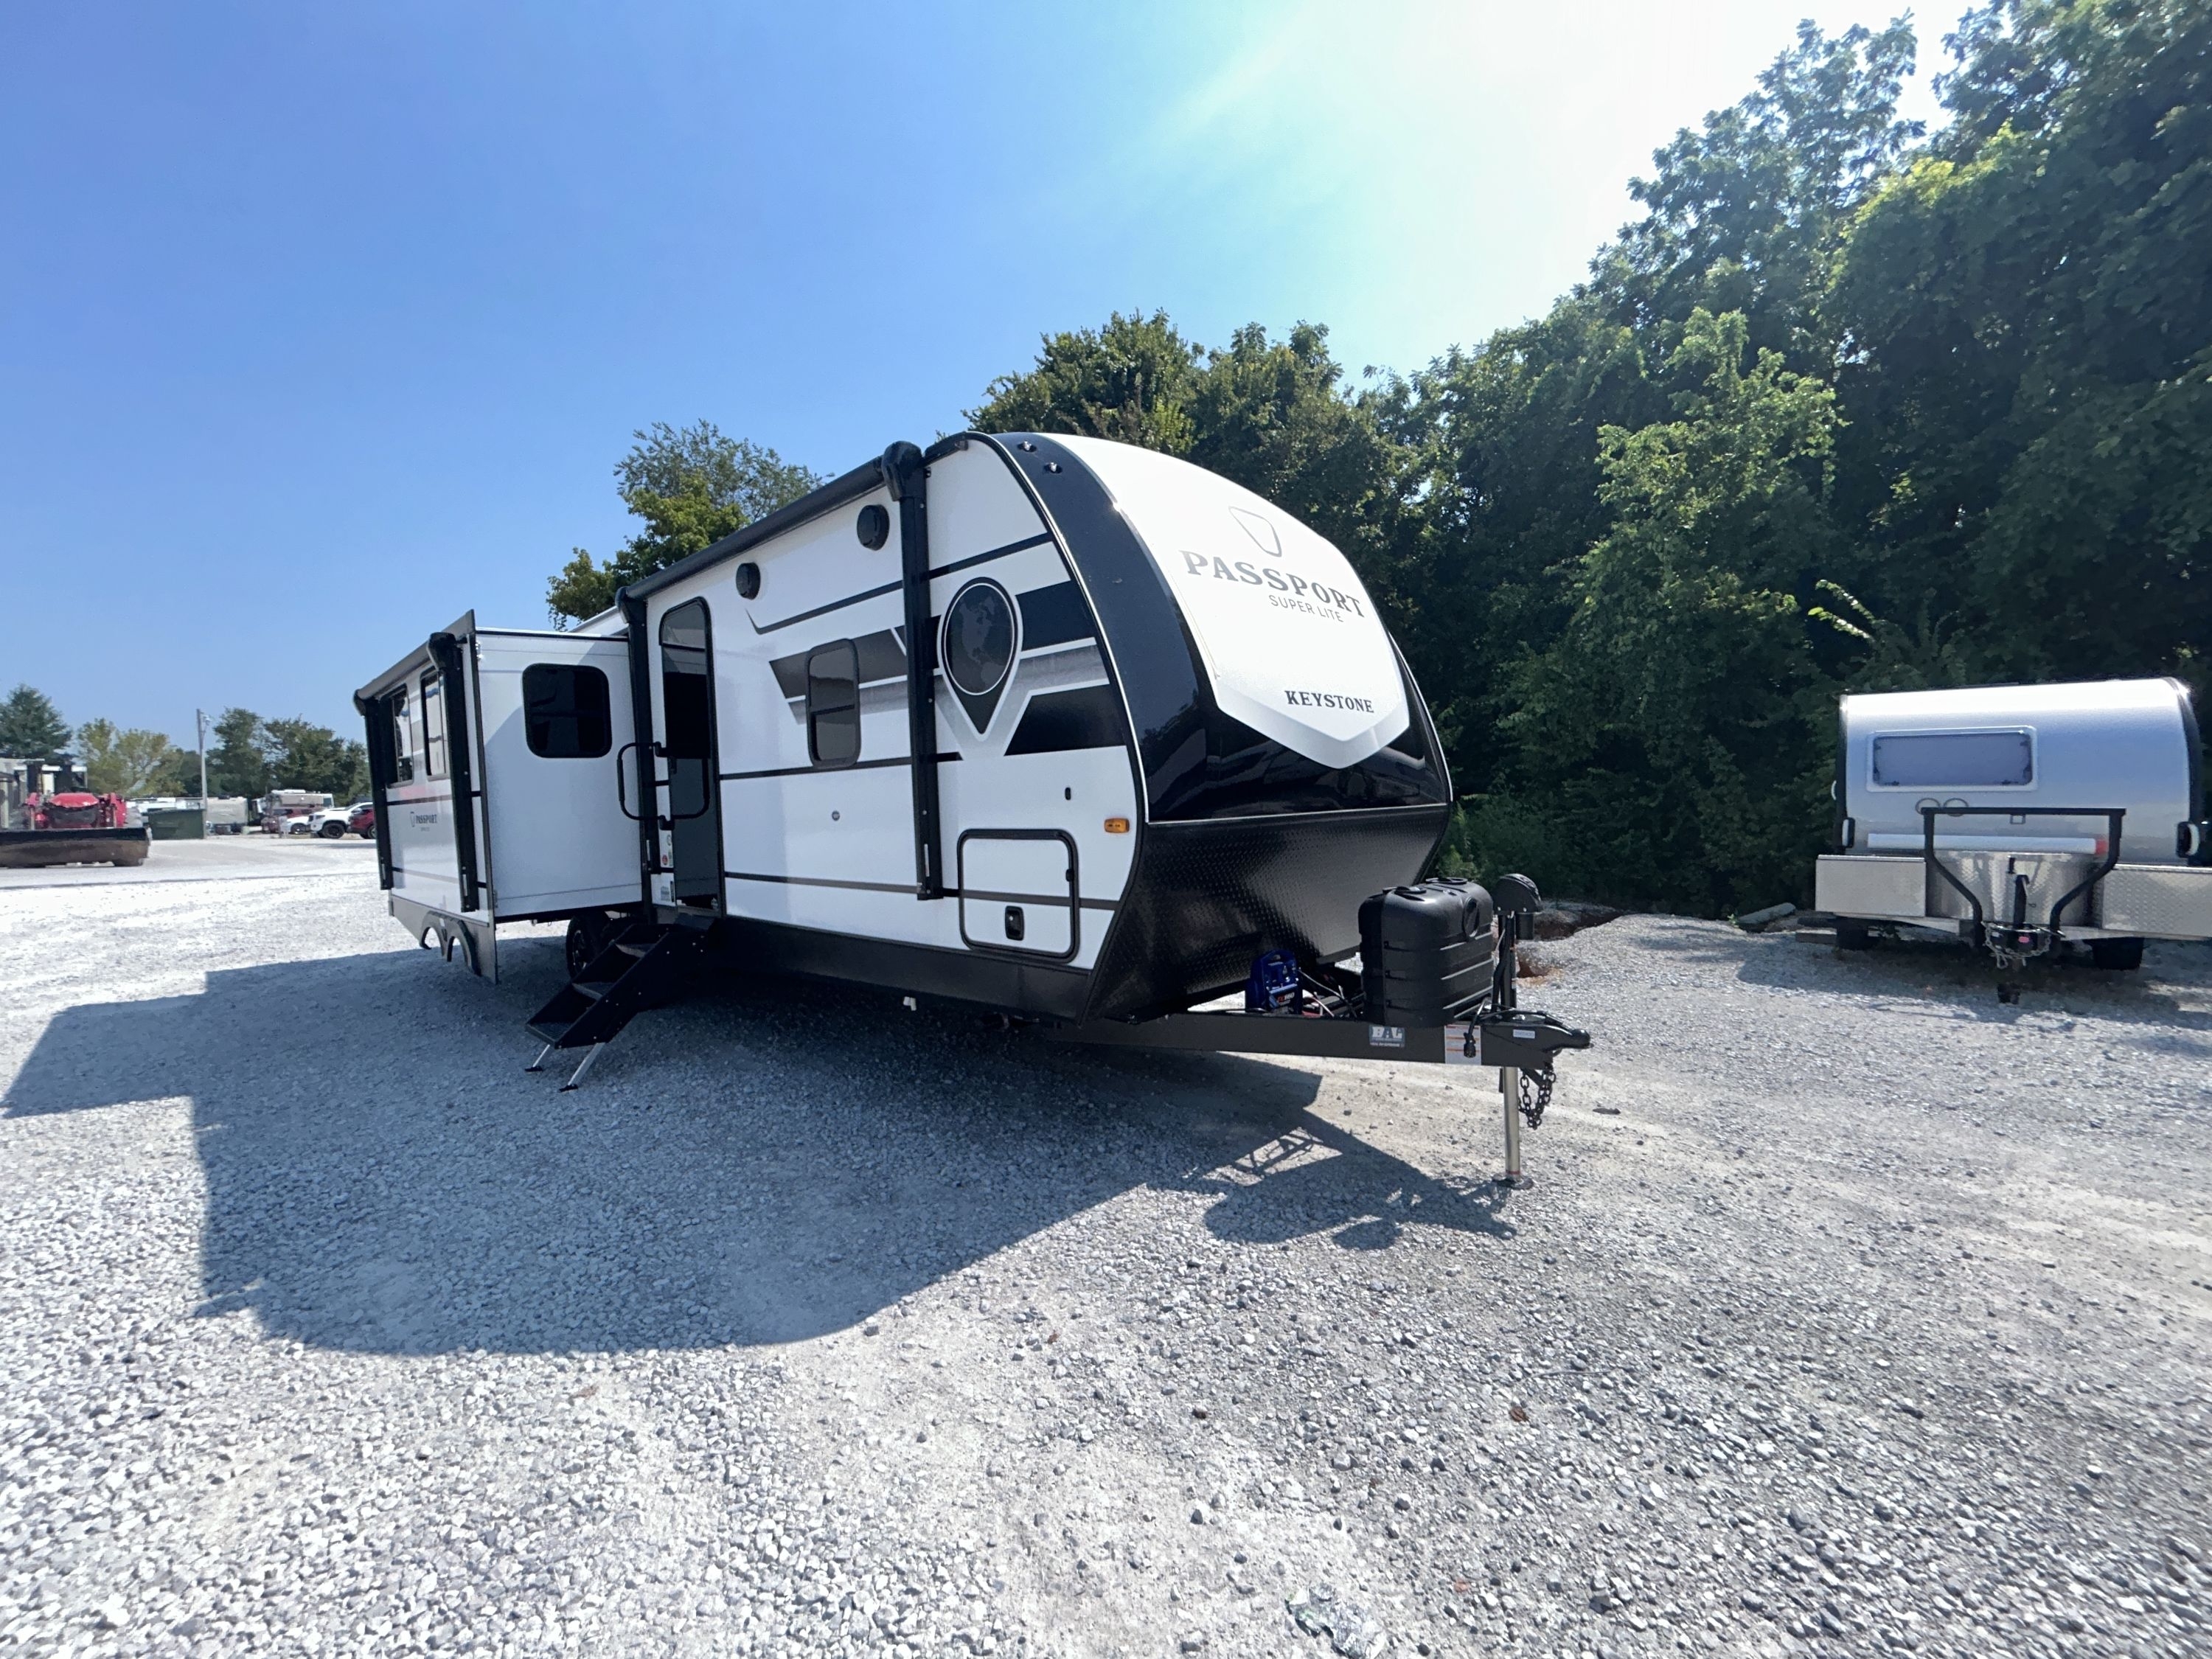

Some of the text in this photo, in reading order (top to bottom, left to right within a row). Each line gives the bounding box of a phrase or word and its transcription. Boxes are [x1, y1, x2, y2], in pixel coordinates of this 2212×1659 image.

[1179, 549, 1364, 617] PASSPORT
[1269, 594, 1343, 622] SUPER LITE
[1284, 690, 1374, 713] KEYSTONE
